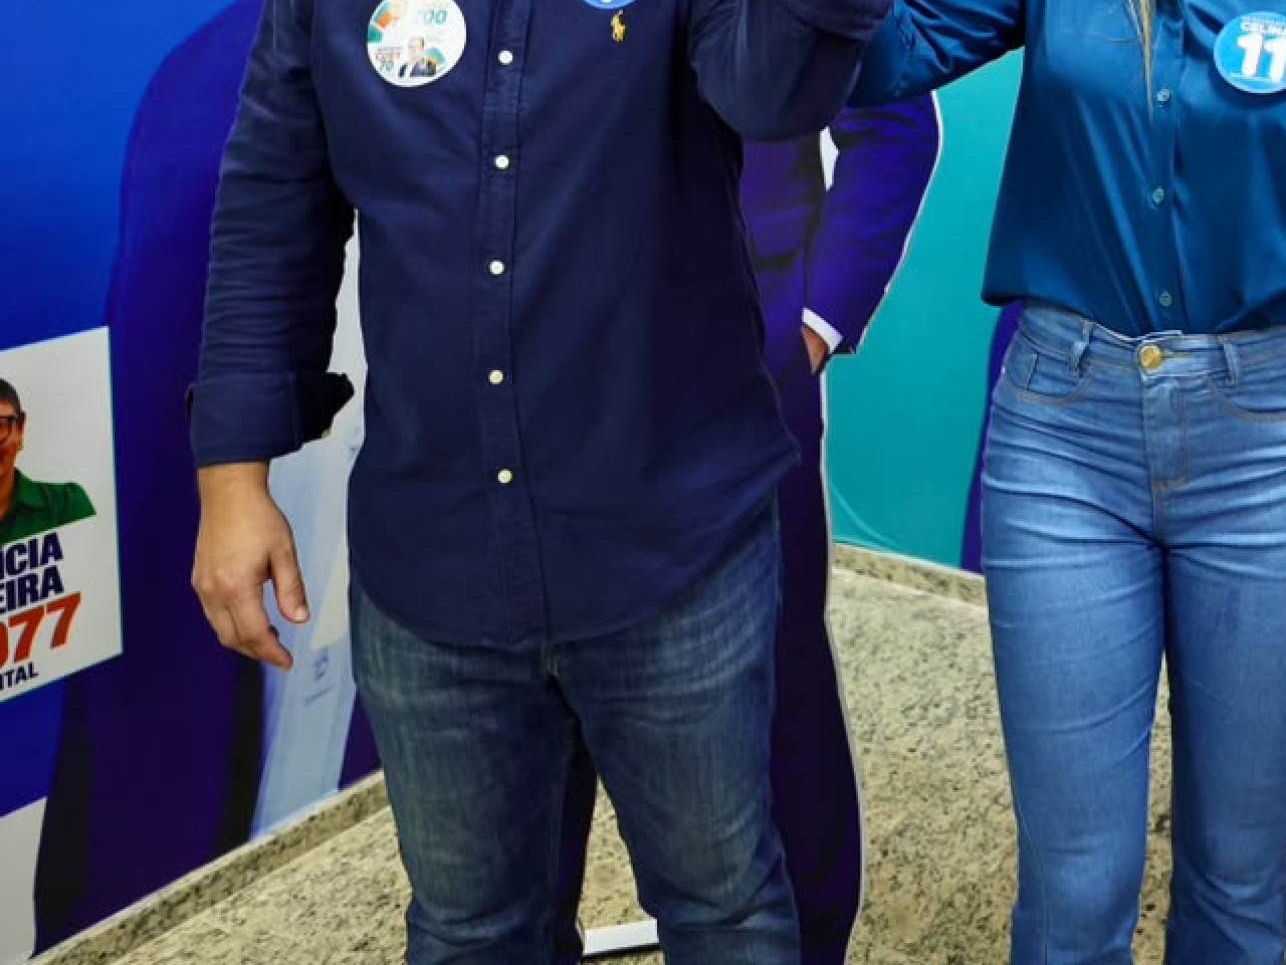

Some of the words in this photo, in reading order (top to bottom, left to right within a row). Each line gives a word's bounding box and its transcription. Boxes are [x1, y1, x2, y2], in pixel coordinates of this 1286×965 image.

[0, 532, 63, 580] CIA
[0, 592, 81, 668] 77
[0, 661, 38, 691] TAL
